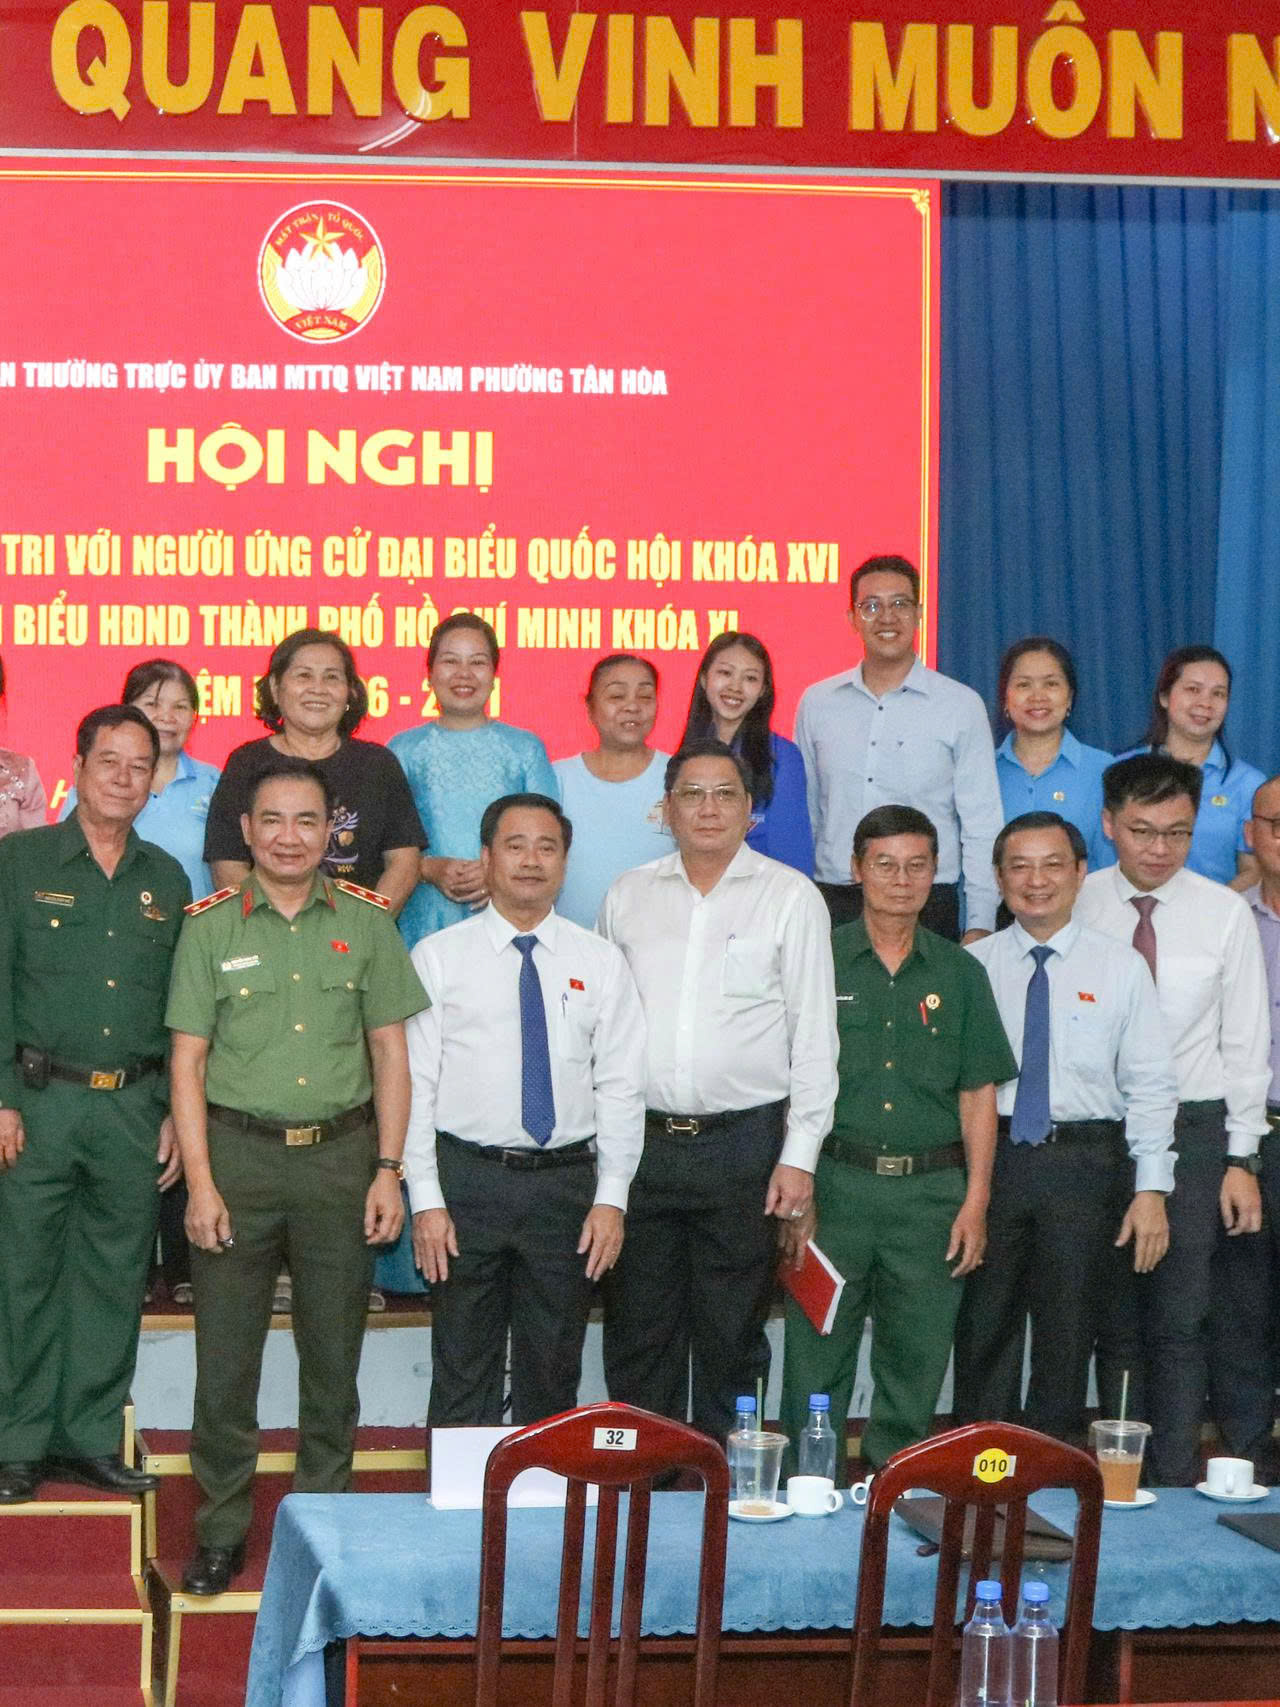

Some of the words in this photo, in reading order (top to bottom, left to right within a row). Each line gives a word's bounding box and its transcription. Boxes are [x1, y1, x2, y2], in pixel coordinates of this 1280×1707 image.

[50, 0, 470, 122] QUANG
[520, 11, 804, 128] VINH
[850, 0, 1183, 140] MUÔN
[21, 358, 119, 389] THƯỜNG
[123, 359, 187, 394] TRỰC
[193, 358, 225, 390] ỦY
[230, 363, 278, 390] BAN
[283, 364, 349, 393] MTTQ
[354, 360, 406, 395] VIỆT
[410, 364, 463, 392] NAM
[469, 362, 564, 394] PHƯỜNG
[569, 363, 615, 395] TÂN
[620, 365, 669, 396] HÒA
[147, 421, 286, 492] HỘI
[307, 428, 494, 494] NGHỊ
[0, 533, 56, 576] TRI
[64, 527, 121, 577] VỚI
[132, 527, 234, 577] NGƯỜI
[244, 528, 312, 578] ỨNG
[322, 525, 372, 578] CỬ
[377, 536, 434, 586] ĐẠI
[444, 522, 517, 579] BIỂU
[527, 525, 617, 585] QUỐC
[627, 532, 682, 588] HỘI
[692, 534, 779, 583] KHÓA
[786, 542, 839, 584] XVI
[13, 589, 89, 647] BIỂU
[99, 604, 190, 646] HĐND
[198, 599, 308, 647] THÀNH
[318, 591, 384, 648] PHỐ
[394, 592, 439, 649] HỒ
[517, 607, 601, 649] MINH
[611, 603, 700, 651] KHÓA
[606, 1429, 624, 1445] 32
[979, 1458, 1007, 1473] 010
